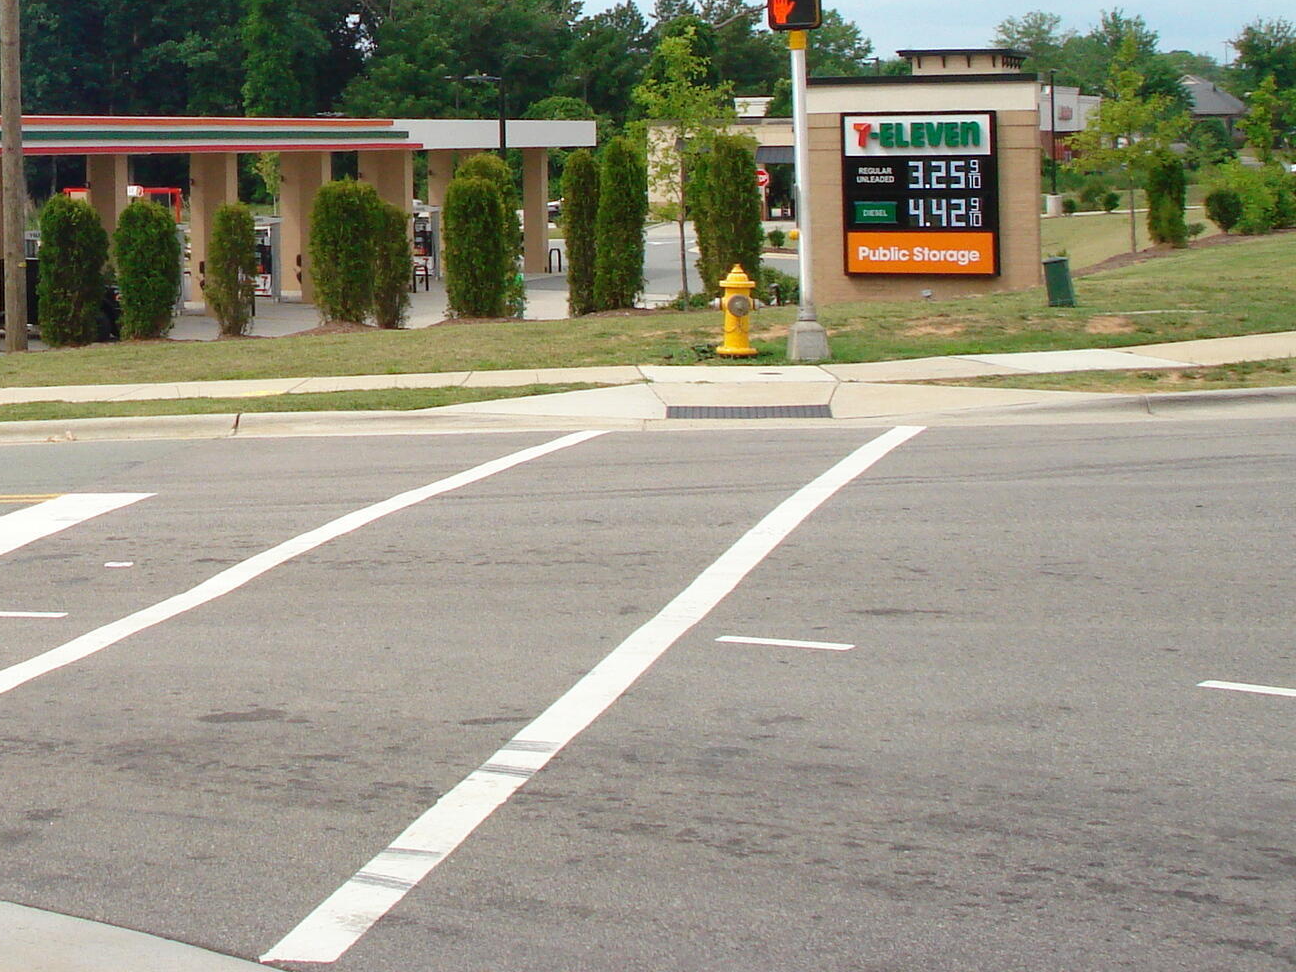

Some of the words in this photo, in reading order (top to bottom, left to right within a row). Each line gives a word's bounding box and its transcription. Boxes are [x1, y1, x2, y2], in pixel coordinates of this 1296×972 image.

[858, 167, 893, 175] REGULAR
[908, 161, 966, 189] 3.25
[856, 175, 895, 184] UNLEADED
[863, 209, 888, 217] DIESEL
[908, 198, 966, 227] 4.42
[857, 245, 910, 262] Public
[912, 246, 980, 266] Storage
